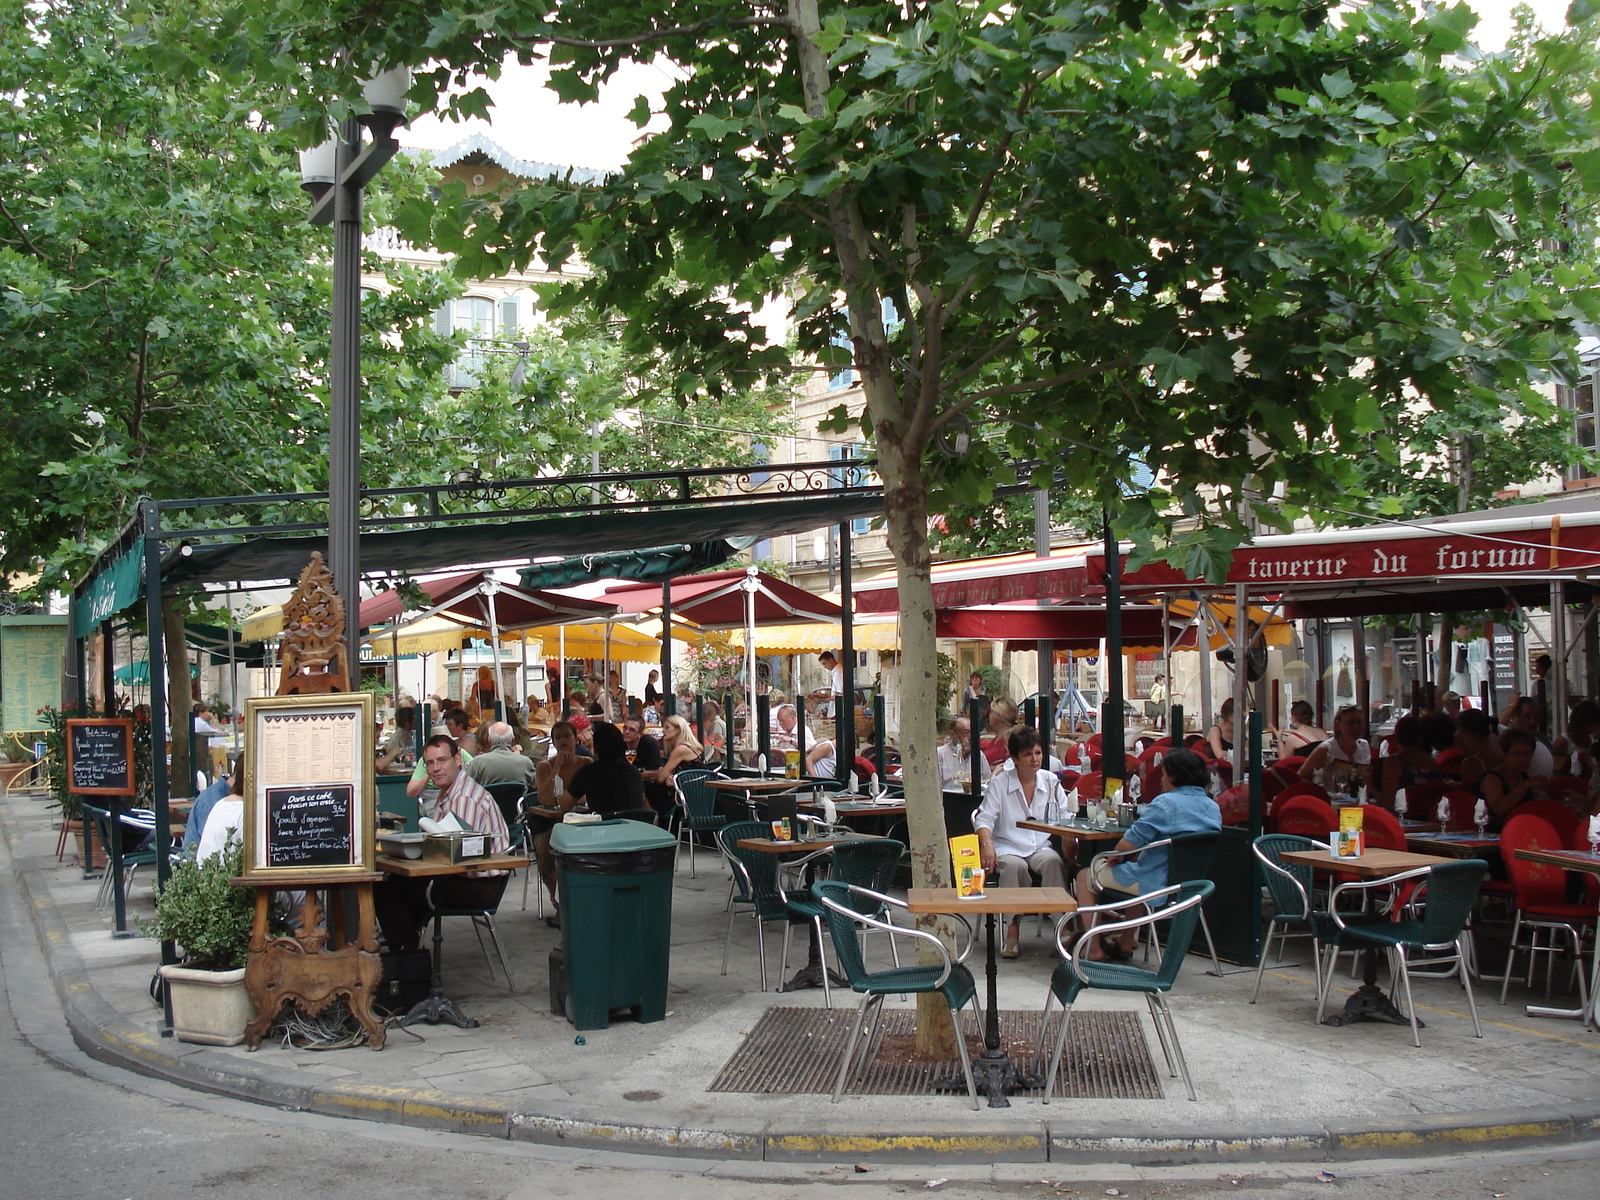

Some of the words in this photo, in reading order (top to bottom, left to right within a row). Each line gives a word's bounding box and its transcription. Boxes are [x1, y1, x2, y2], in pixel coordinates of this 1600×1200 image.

[1249, 556, 1347, 578] taverne
[1373, 548, 1408, 574] du
[1436, 544, 1536, 570] forum
[1494, 636, 1514, 644] DIESEL
